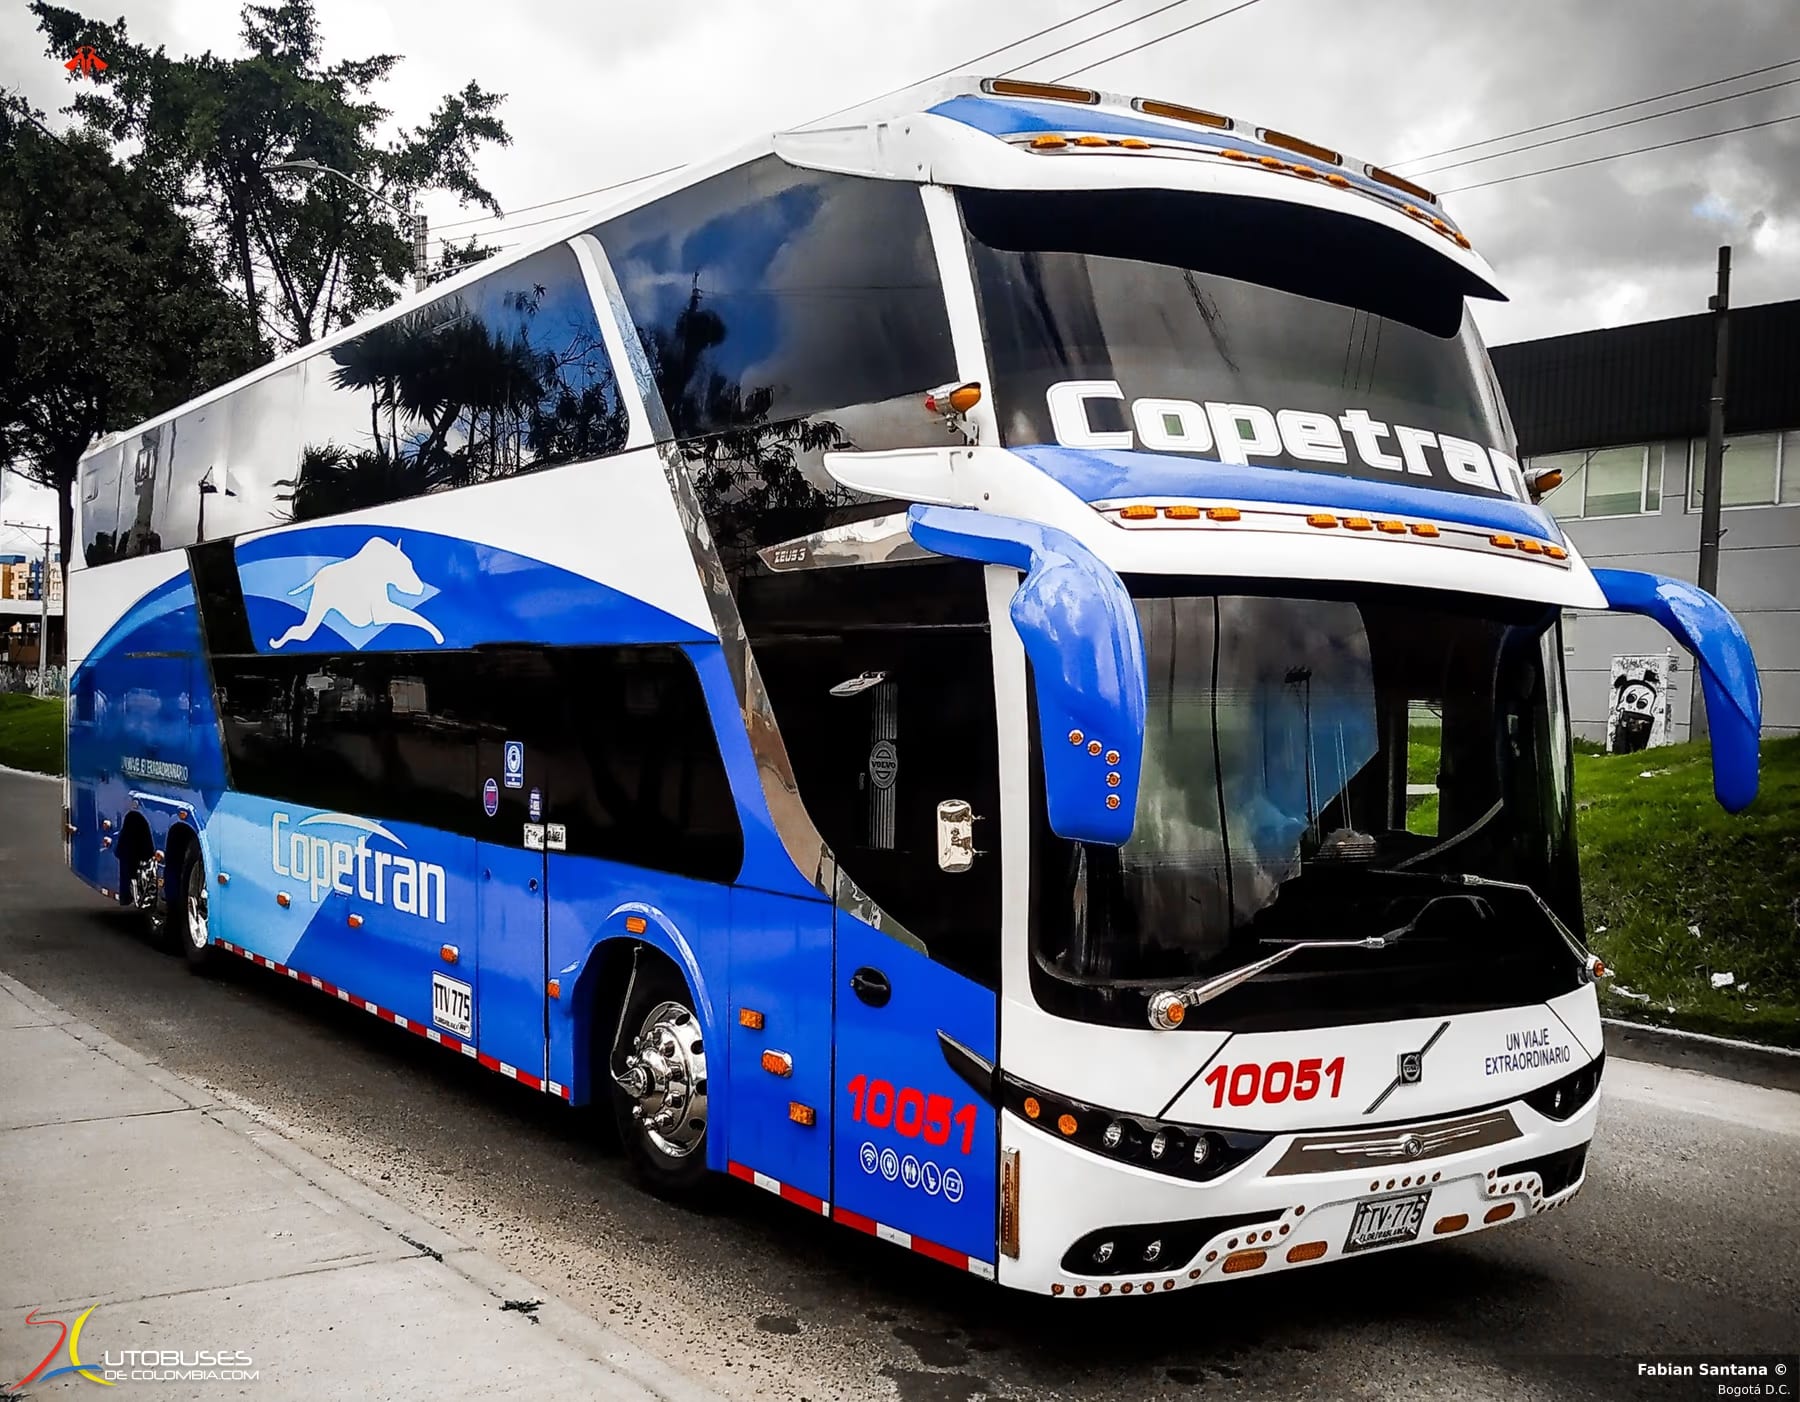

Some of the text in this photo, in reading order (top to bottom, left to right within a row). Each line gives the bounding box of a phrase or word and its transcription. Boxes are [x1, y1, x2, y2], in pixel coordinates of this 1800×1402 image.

[1047, 380, 1531, 503] Copetran
[774, 550, 798, 564] ZEUS
[272, 812, 446, 923] Copetran
[434, 982, 470, 1021] TTV 775
[1485, 1045, 1570, 1075] EXTRAORDINARIO
[1506, 1028, 1549, 1051] UN VIAJE
[1205, 1056, 1345, 1108] 10051
[847, 1074, 977, 1155] 10051
